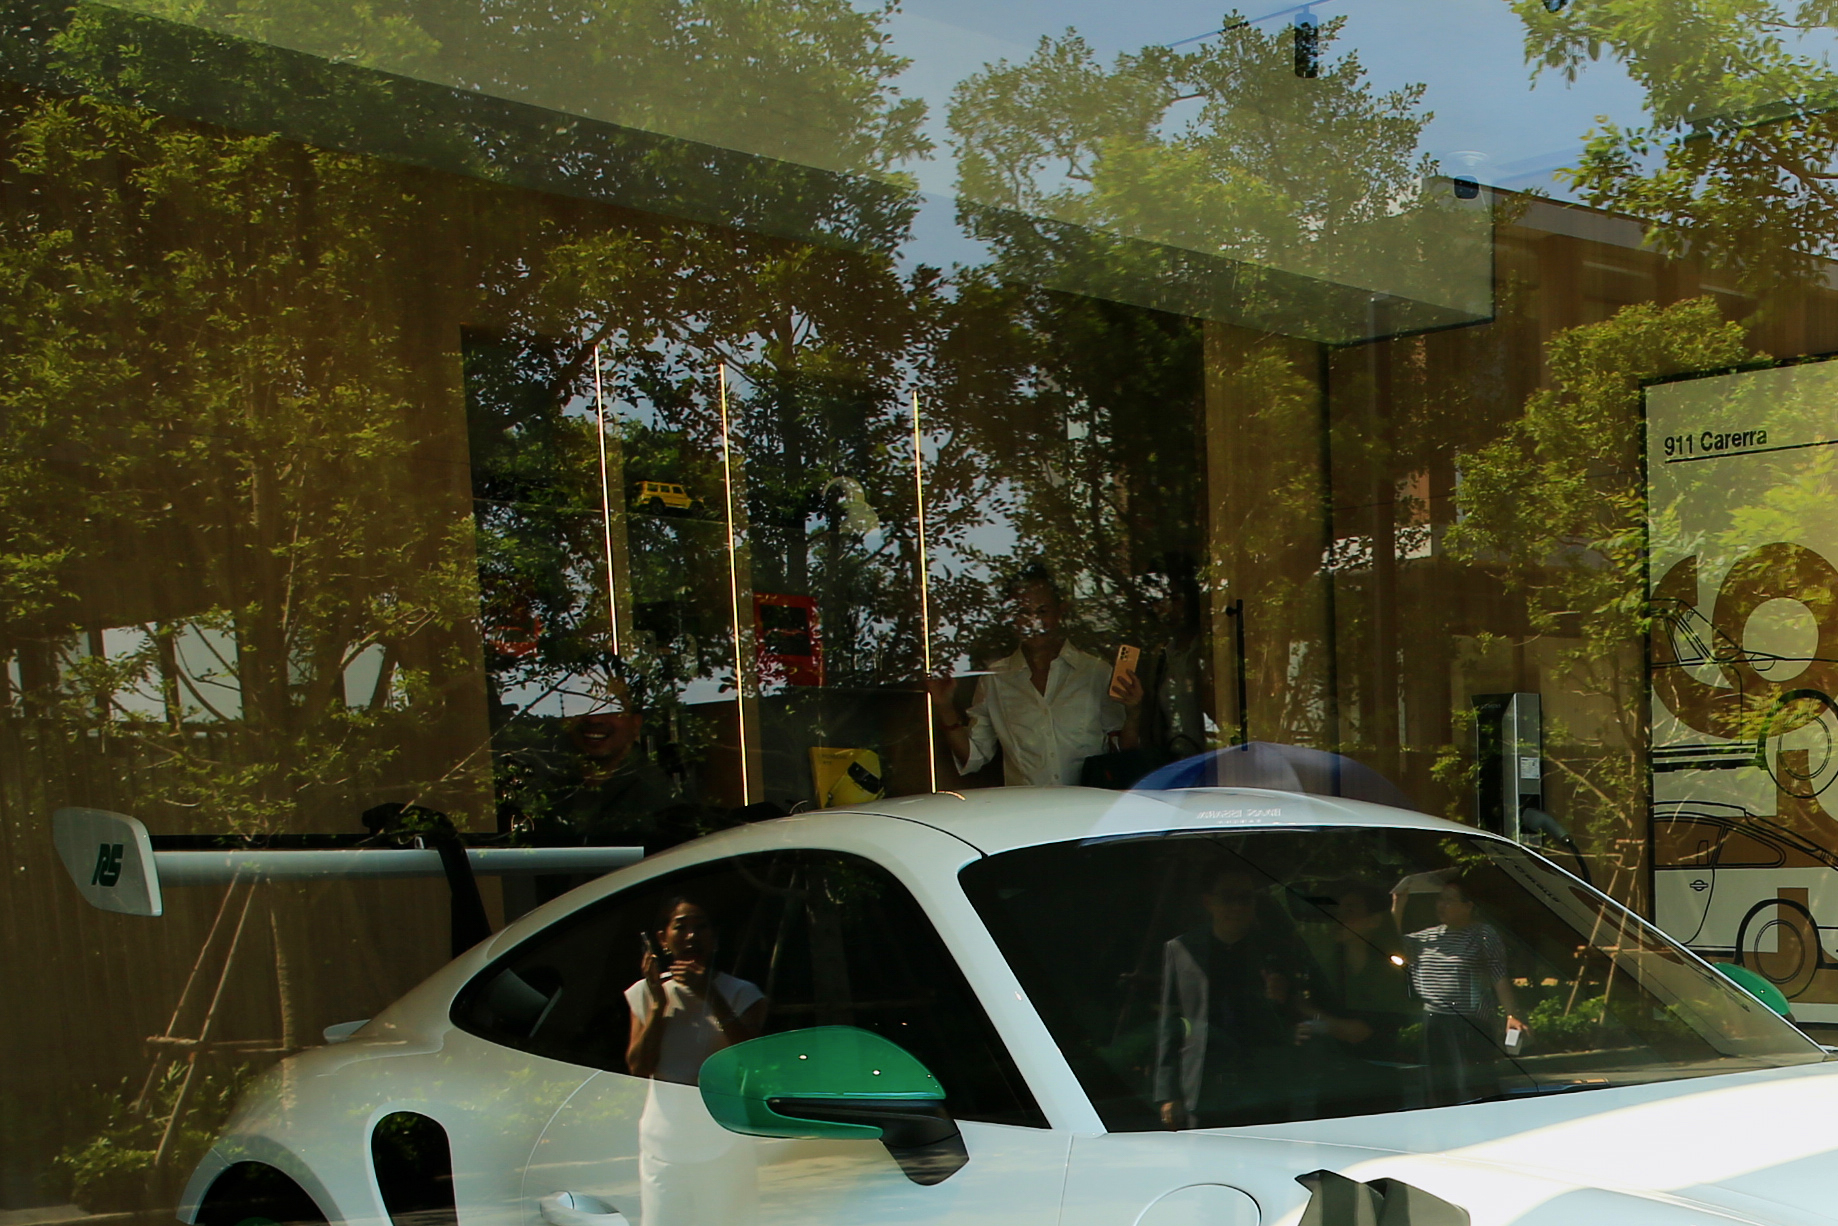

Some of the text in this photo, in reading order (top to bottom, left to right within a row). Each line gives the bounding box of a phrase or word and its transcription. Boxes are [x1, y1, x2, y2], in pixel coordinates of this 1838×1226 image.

[1664, 429, 1767, 456] 911 Carerra
[91, 843, 124, 887] RS
